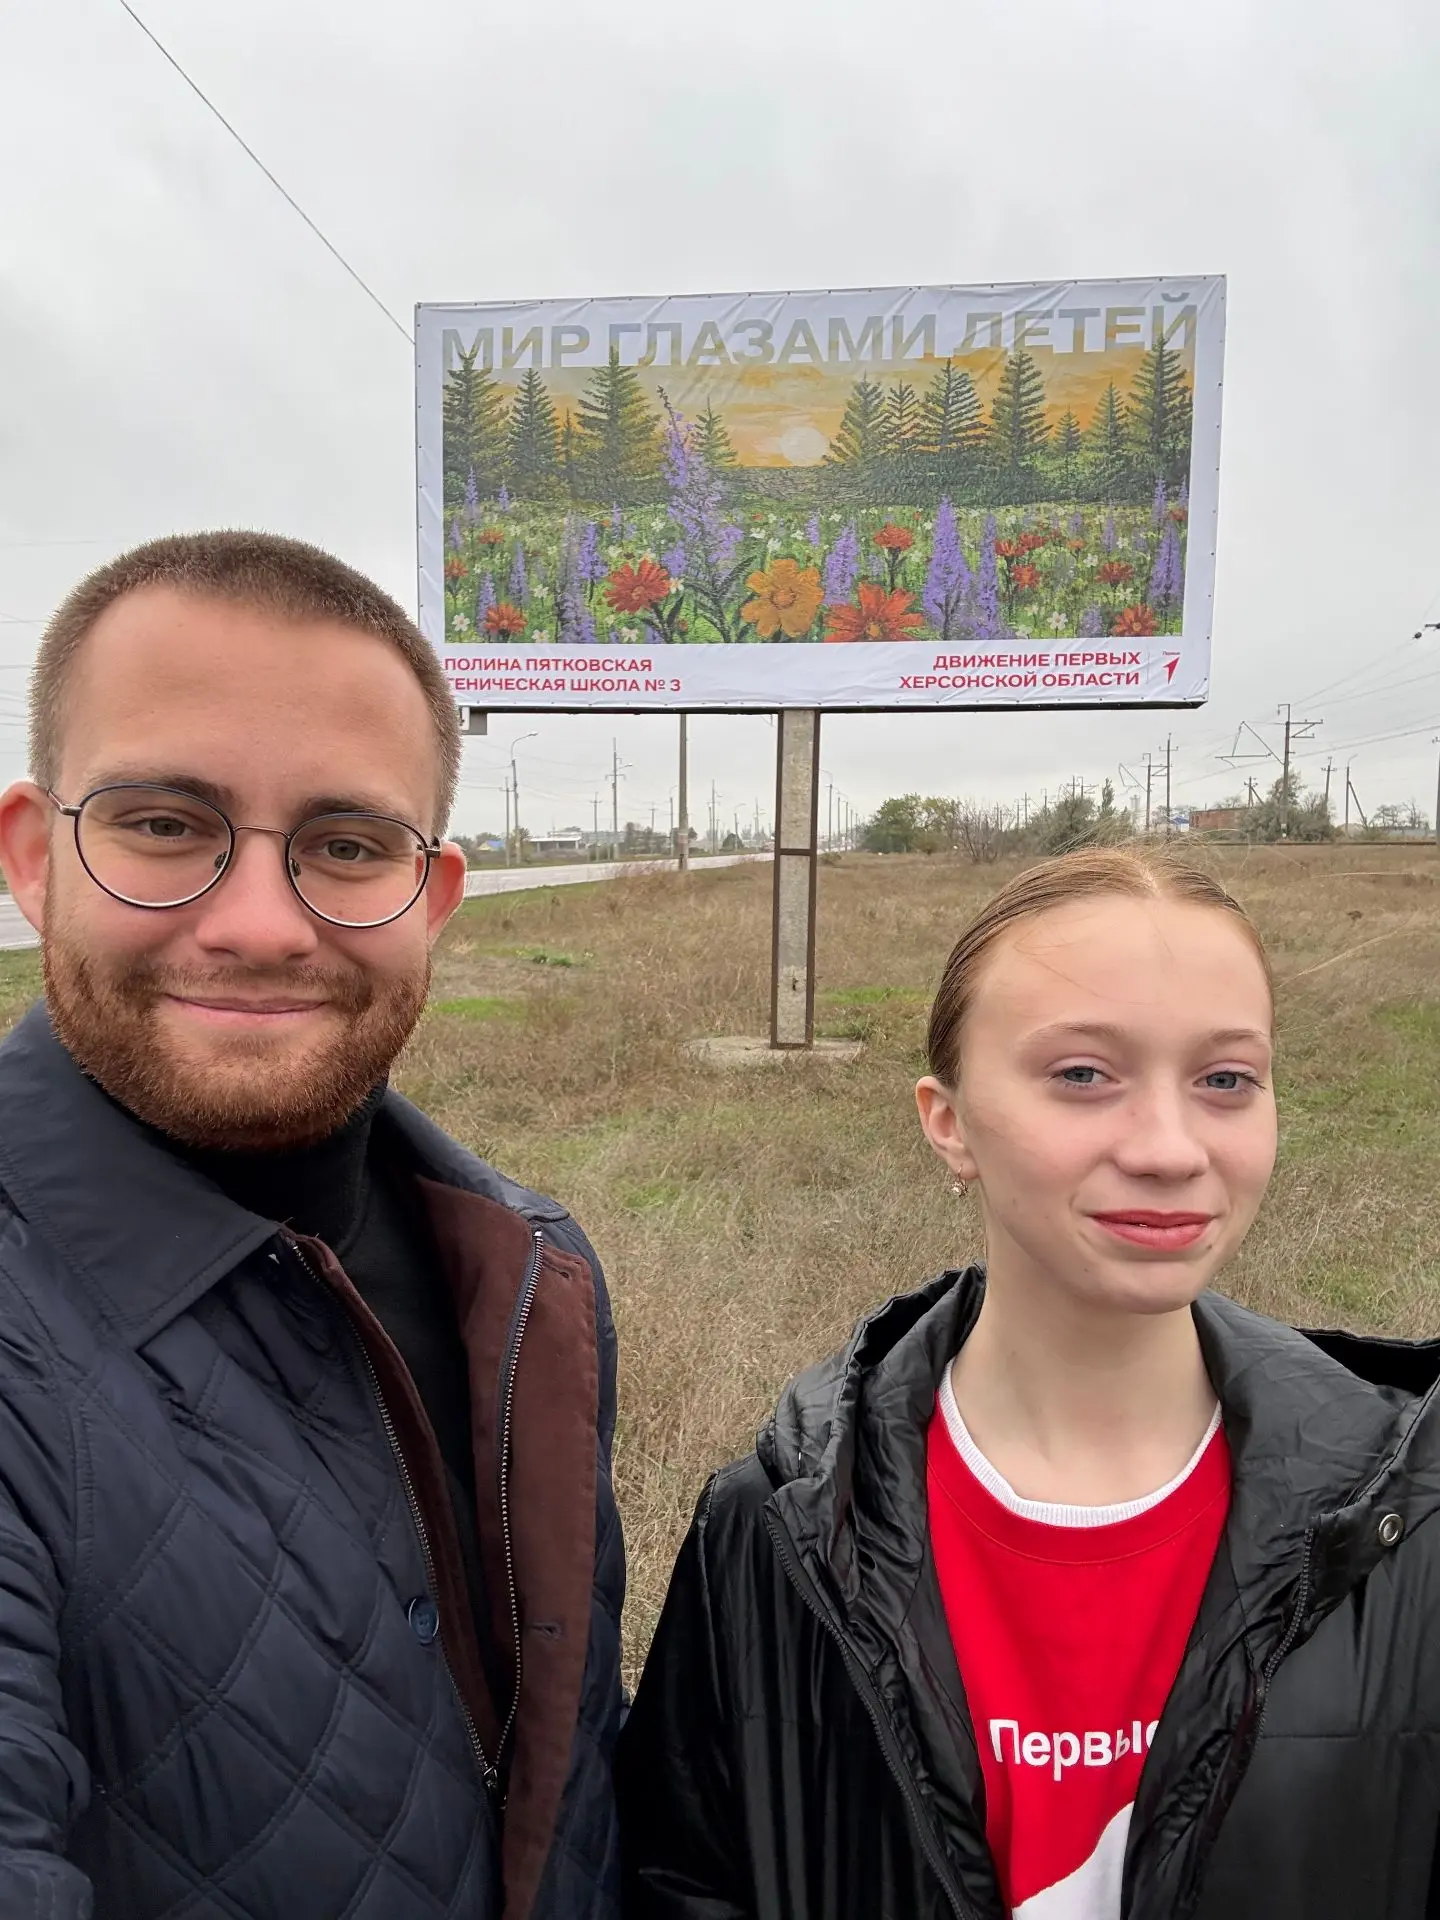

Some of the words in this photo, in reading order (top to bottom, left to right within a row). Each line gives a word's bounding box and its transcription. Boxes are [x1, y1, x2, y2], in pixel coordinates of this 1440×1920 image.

[442, 325, 590, 369] МИР
[607, 313, 936, 367] ГЛАЗАМИ
[953, 292, 1197, 356] ДЕТЕЙ
[445, 658, 521, 671] ПОЛИНА
[526, 659, 652, 671] ПЯТКОВСКАЯ
[933, 655, 1050, 670] ДВИЖЕНИЕ
[1054, 651, 1140, 666] ПЕРВЫХ
[570, 679, 640, 691] ШКОЛА
[645, 680, 665, 691] №
[670, 680, 681, 691] 3
[899, 671, 1037, 689] ХЕРСОНСКОЙ
[1042, 672, 1139, 687] ОБЛАСТИ
